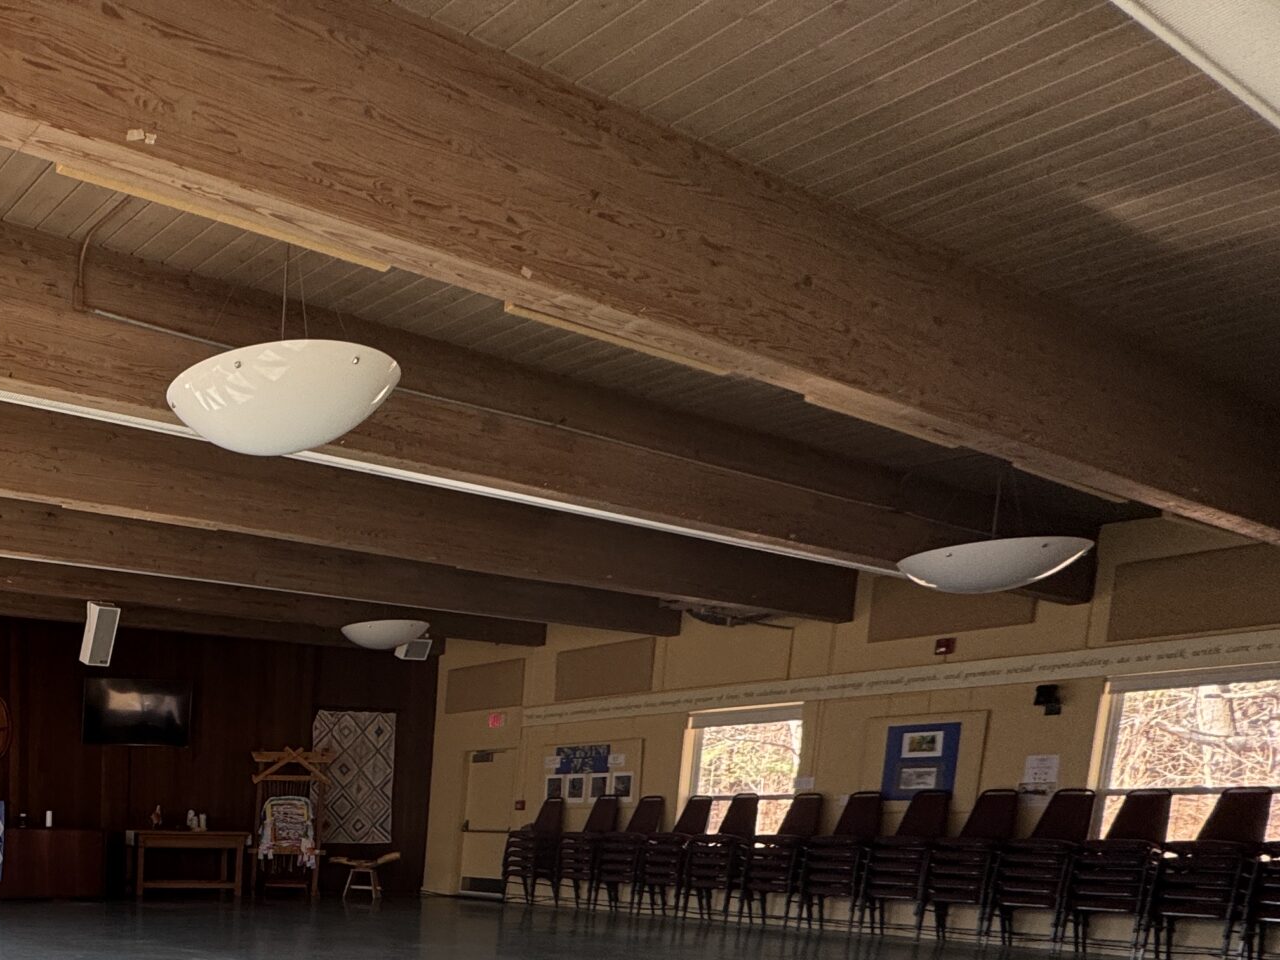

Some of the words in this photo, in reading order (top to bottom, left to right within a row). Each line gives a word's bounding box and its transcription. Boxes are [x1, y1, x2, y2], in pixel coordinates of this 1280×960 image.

[942, 671, 962, 679] and
[964, 668, 1002, 679] promote
[1005, 664, 1034, 673] social
[1135, 653, 1152, 661] we
[1155, 648, 1187, 660] walk
[1190, 645, 1223, 656] with
[1223, 644, 1251, 653] care
[1254, 641, 1273, 650] on
